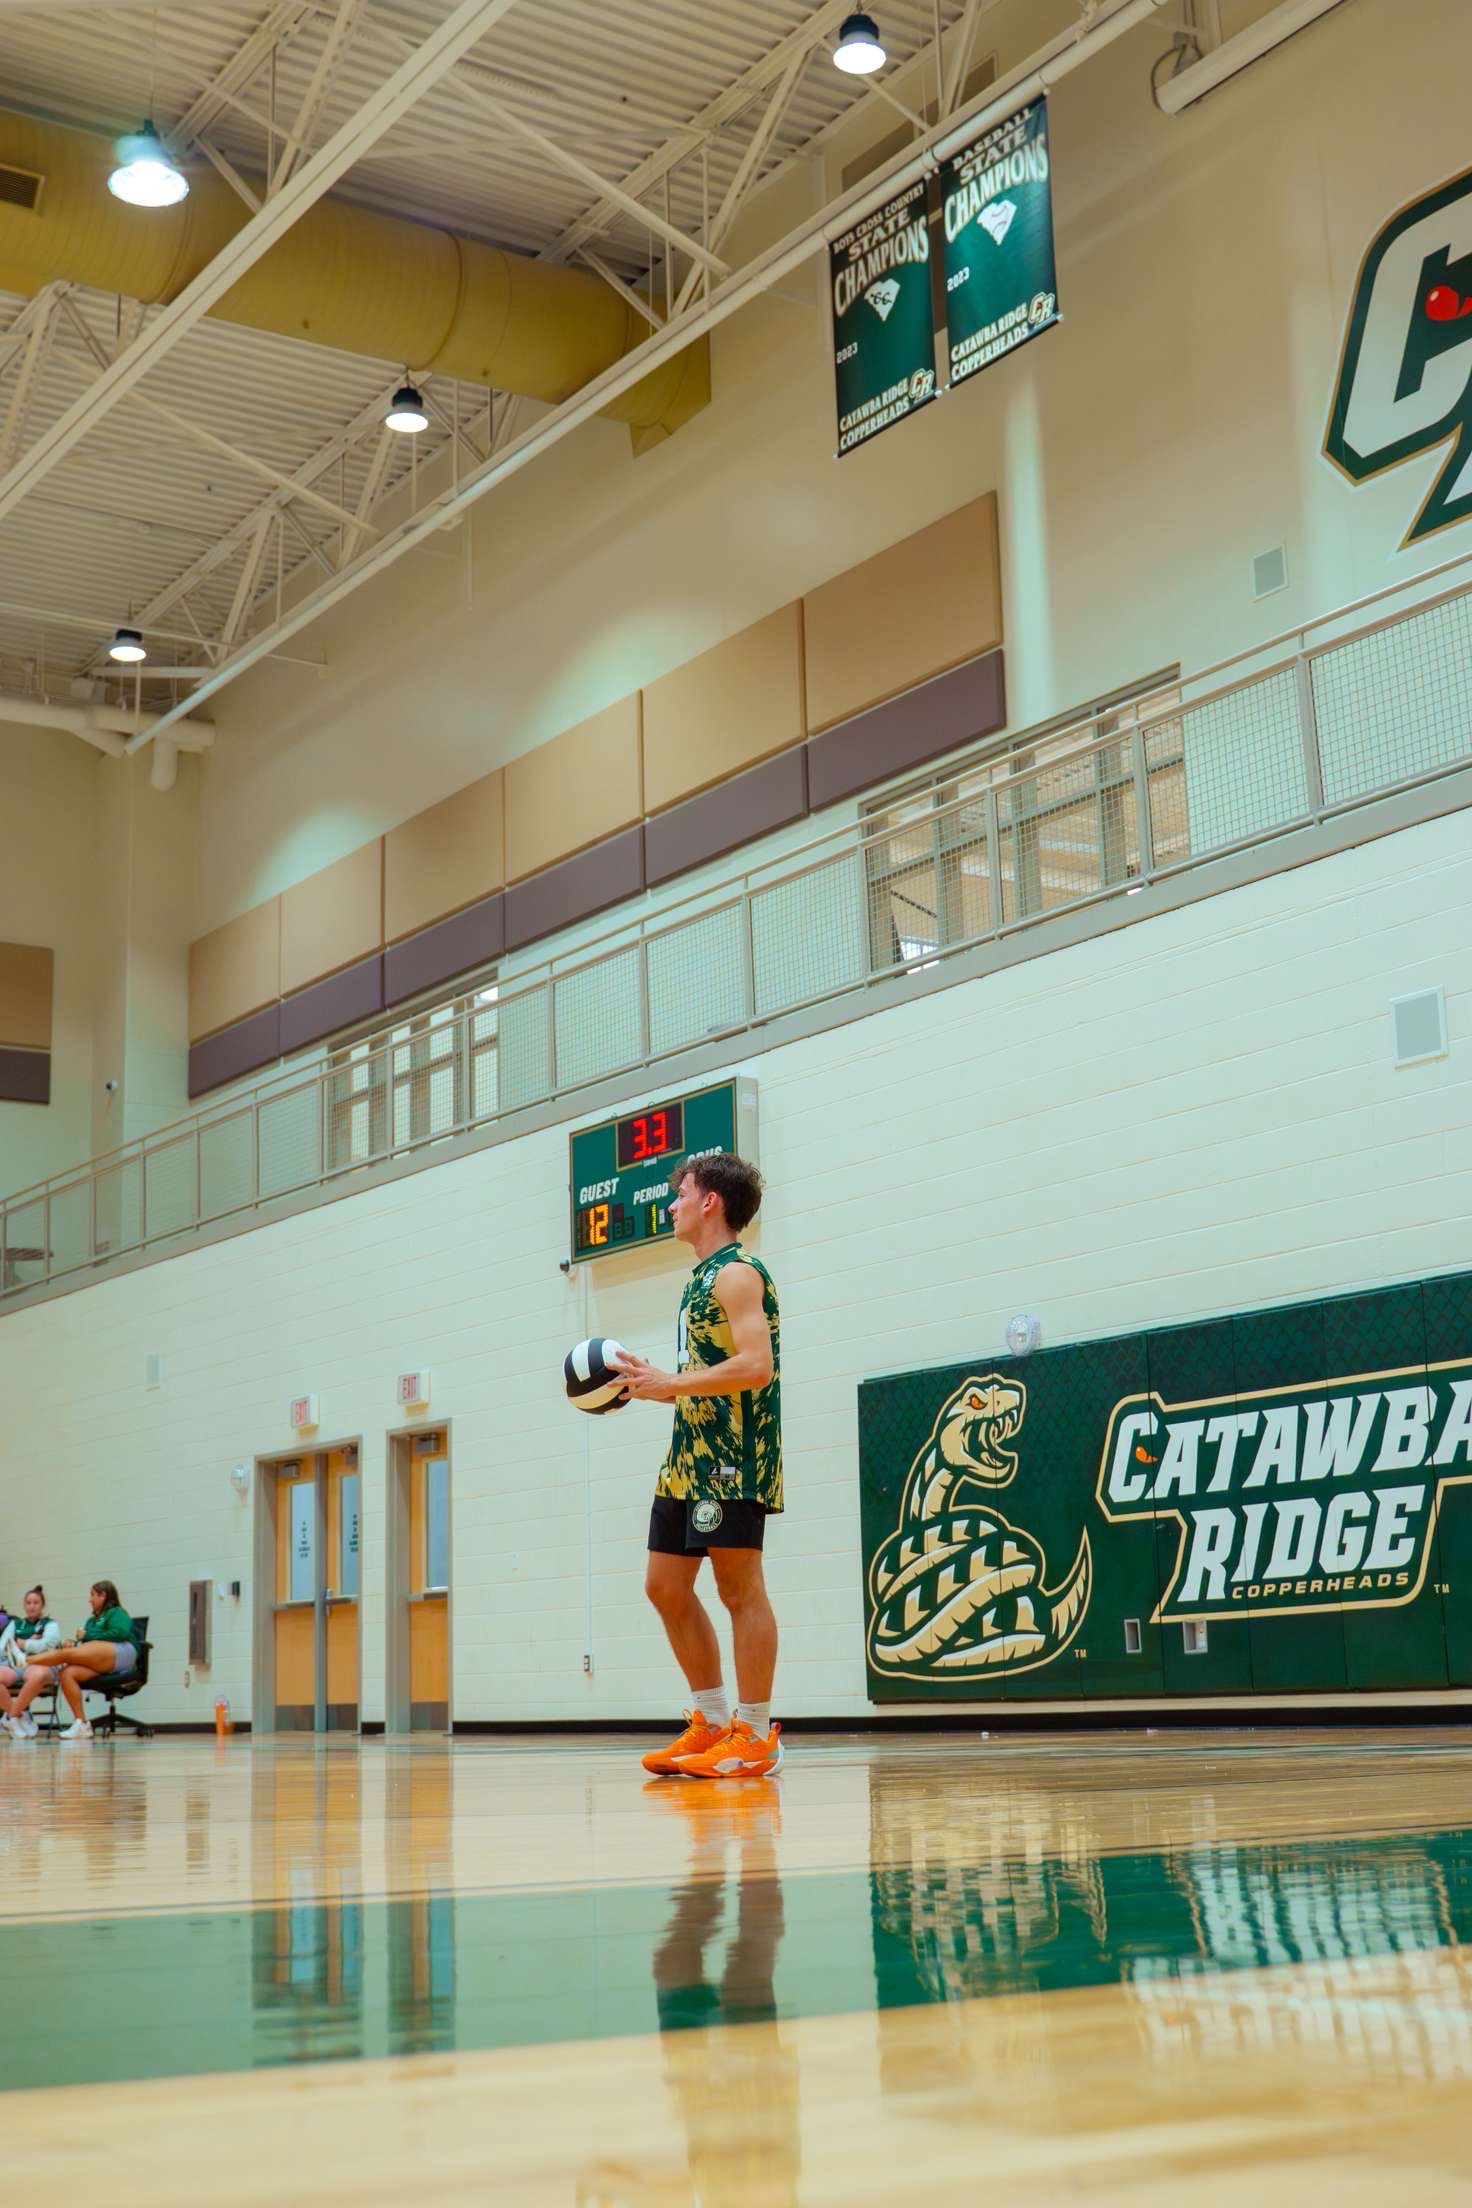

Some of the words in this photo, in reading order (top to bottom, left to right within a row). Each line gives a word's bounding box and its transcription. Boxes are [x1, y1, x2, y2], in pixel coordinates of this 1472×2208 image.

[953, 108, 1033, 172] BASEBALL
[960, 124, 1027, 186] STATE
[856, 211, 884, 237] CROSS
[885, 182, 924, 218] COUNTRY
[944, 132, 1049, 243] CHAMPIONS
[848, 208, 910, 262] STATE
[834, 215, 929, 317] CHAMPIONS
[946, 266, 970, 292] 2023
[836, 342, 858, 364] 2023
[951, 322, 998, 362] CATAWBA
[998, 302, 1028, 337] RIDGE
[951, 321, 1029, 381] COPPERHEADS
[840, 396, 882, 432] CATAWBA
[882, 377, 909, 408] RIDGE
[840, 396, 910, 450] COPPERHEADS
[579, 1177, 620, 1204] GUEST
[633, 1182, 669, 1205] PERIOD
[589, 1203, 609, 1245] 12
[1108, 1379, 1472, 1503] CATAWBA
[1177, 1484, 1426, 1602] RIDGE
[1232, 1572, 1409, 1599] COPPERHEADS
[1434, 1583, 1450, 1594] TM
